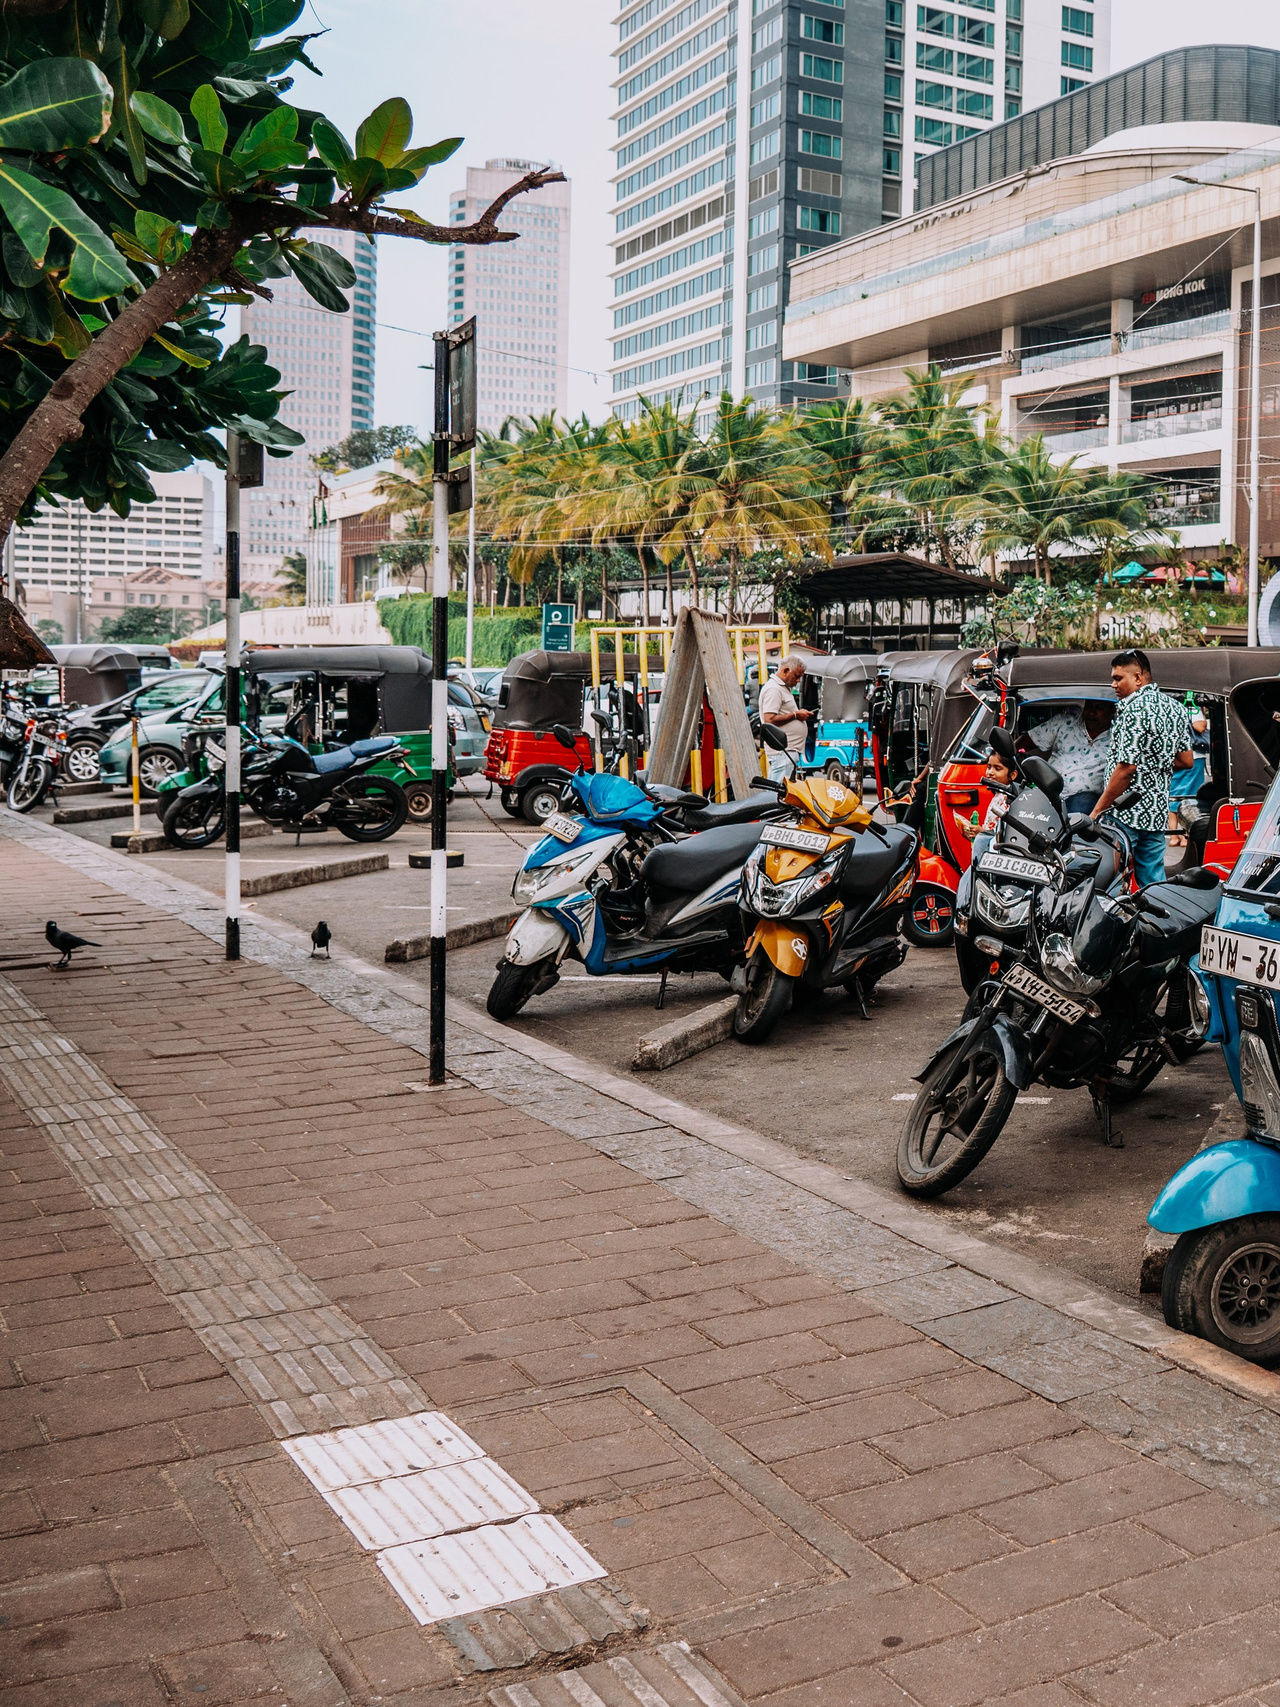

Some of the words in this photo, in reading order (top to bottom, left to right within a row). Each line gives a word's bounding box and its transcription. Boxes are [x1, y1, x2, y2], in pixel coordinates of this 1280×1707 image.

[1156, 285, 1183, 301] MONG
[1184, 279, 1206, 294] KOK
[994, 857, 1049, 878] BIC802
[1202, 947, 1215, 967] WP
[1007, 973, 1022, 985] WP
